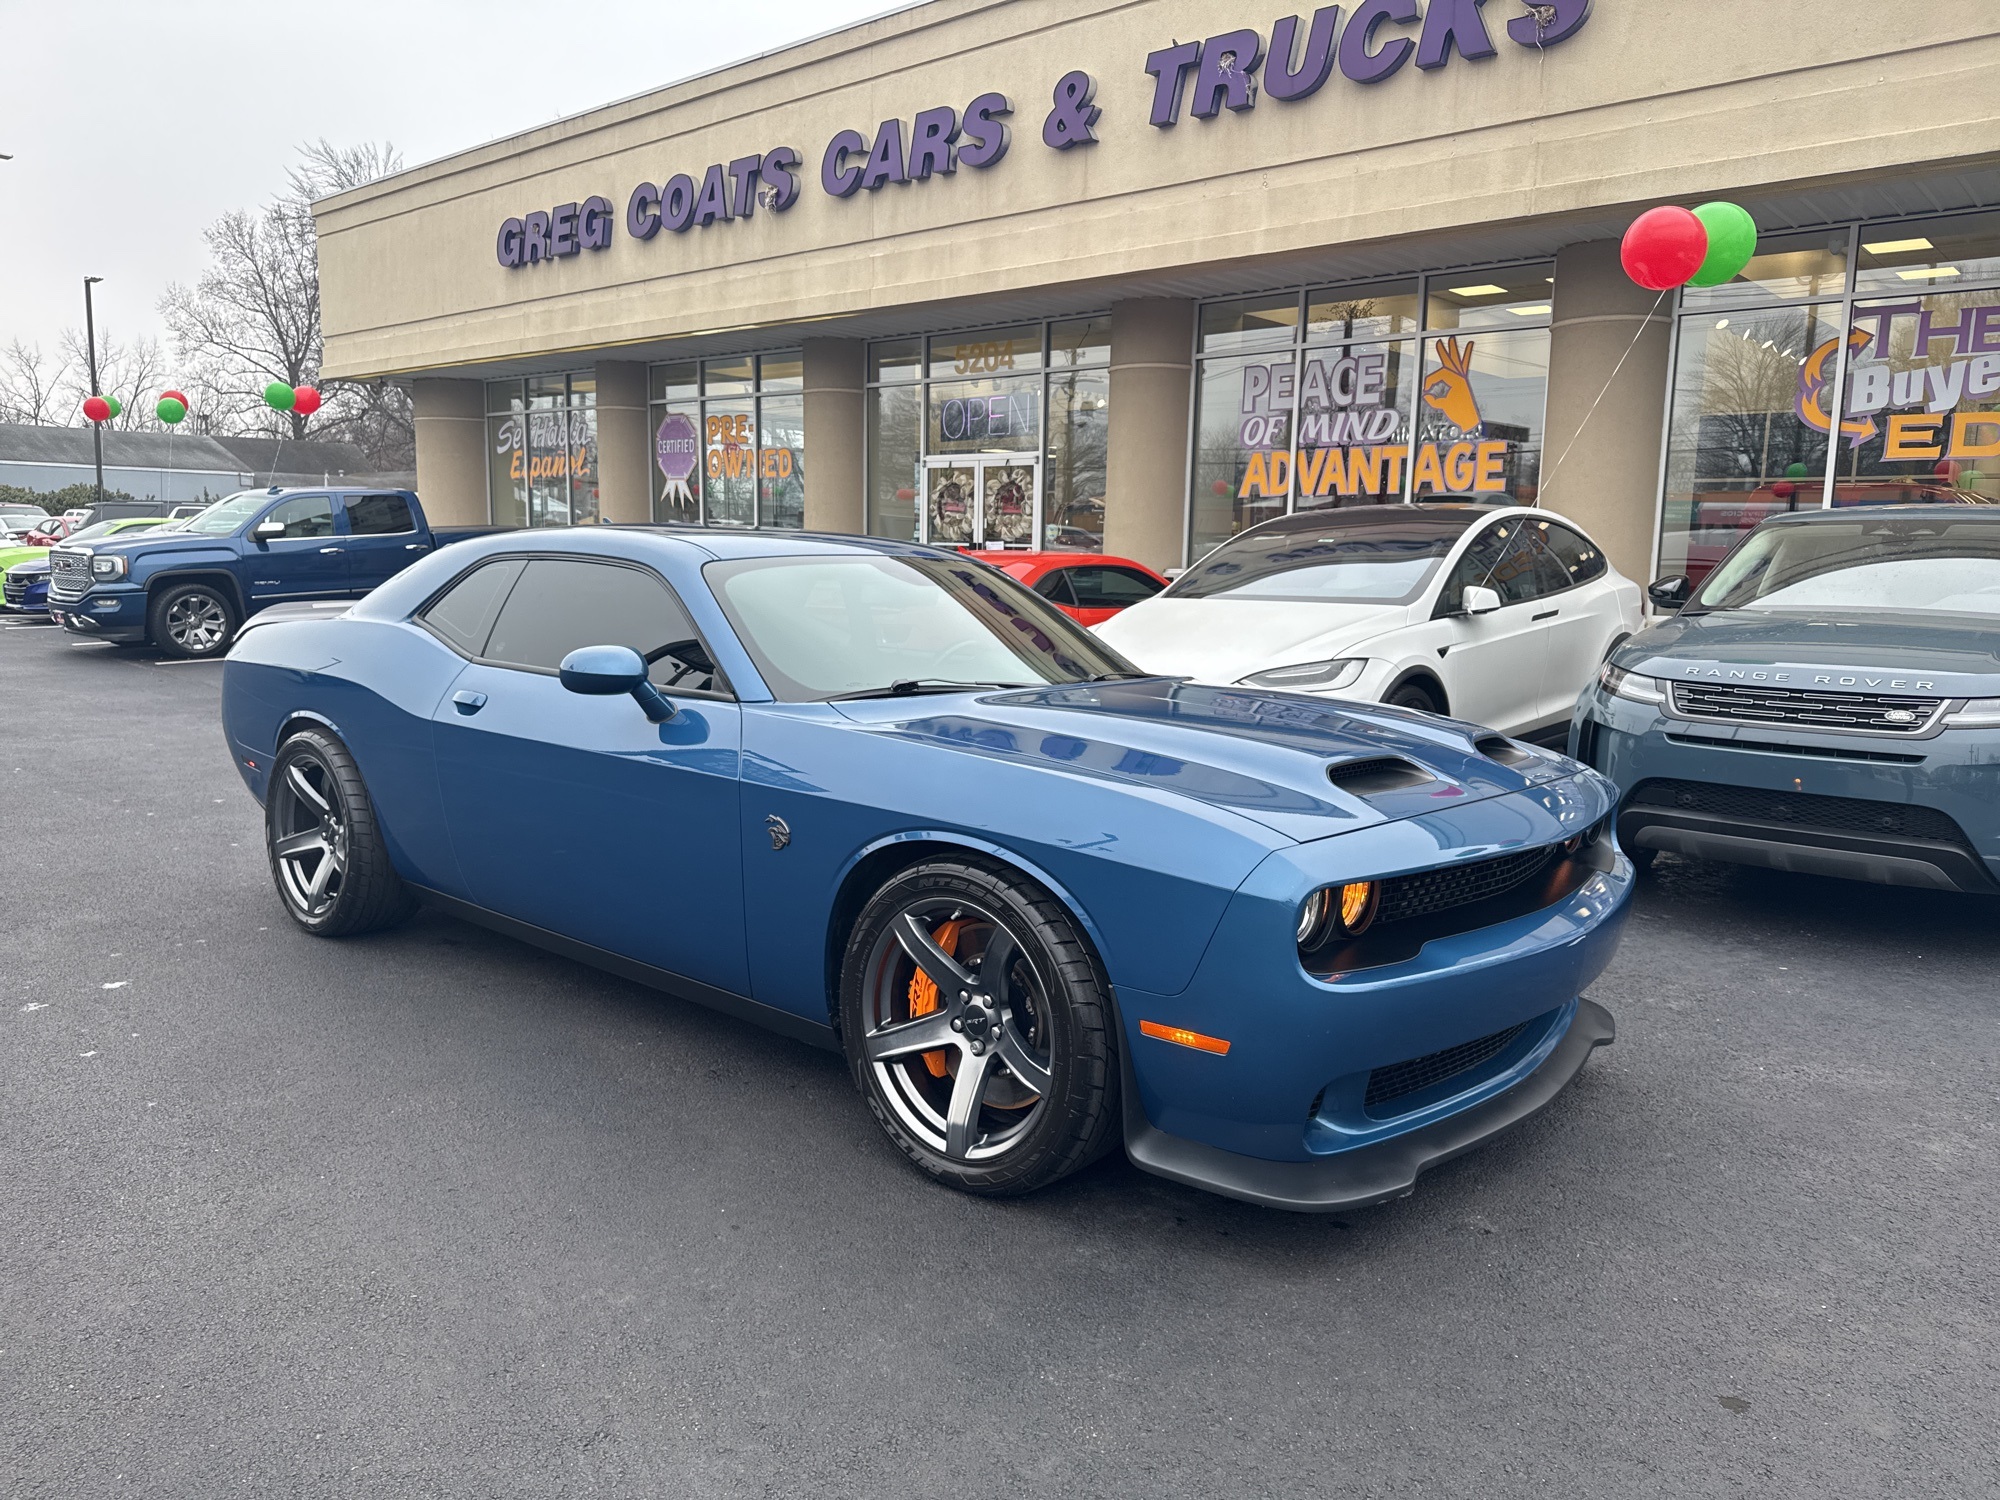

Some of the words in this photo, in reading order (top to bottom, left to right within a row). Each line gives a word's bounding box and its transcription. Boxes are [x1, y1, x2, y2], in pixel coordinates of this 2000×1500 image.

[497, 195, 613, 268] GREG
[627, 146, 802, 240] COATS
[821, 92, 1014, 198] CARS
[1043, 70, 1102, 150] &
[1853, 300, 2000, 360] THE
[954, 340, 1016, 375] 5204
[1242, 353, 1385, 413] PEACE
[1846, 354, 2000, 418] Buye
[496, 420, 522, 454] Se
[531, 413, 592, 448] Habla
[942, 394, 1031, 439] OPEN
[1240, 415, 1287, 449] OF
[1298, 408, 1399, 446] MIND
[1879, 412, 2000, 462] ED
[658, 439, 695, 454] CERTIFIED
[707, 447, 793, 479] OWNED
[1238, 440, 1508, 498] ADVANTAGE
[1685, 667, 1790, 682] RANGE
[1814, 675, 1934, 690] ROVER
